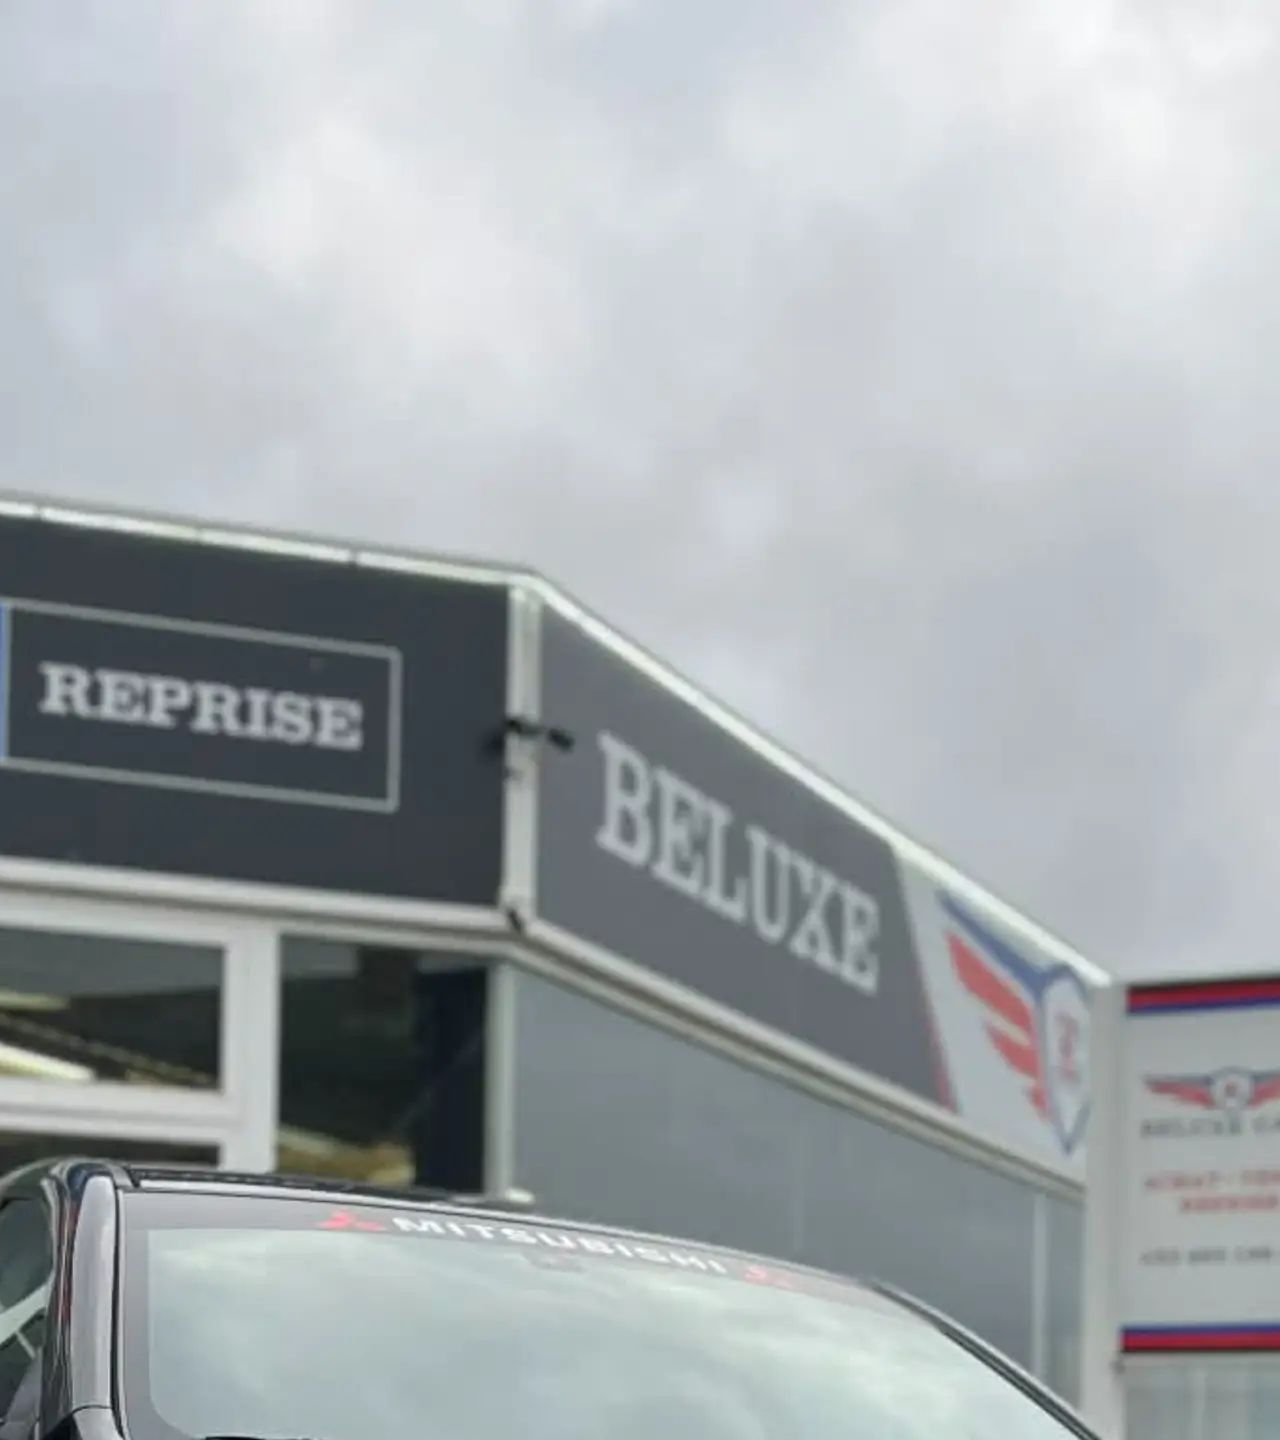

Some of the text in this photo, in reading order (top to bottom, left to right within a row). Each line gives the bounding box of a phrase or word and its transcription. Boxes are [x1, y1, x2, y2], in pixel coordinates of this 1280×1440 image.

[38, 661, 365, 752] REPRISE
[595, 730, 880, 997] BELUXE
[392, 1216, 728, 1275] MITSUBISHI
